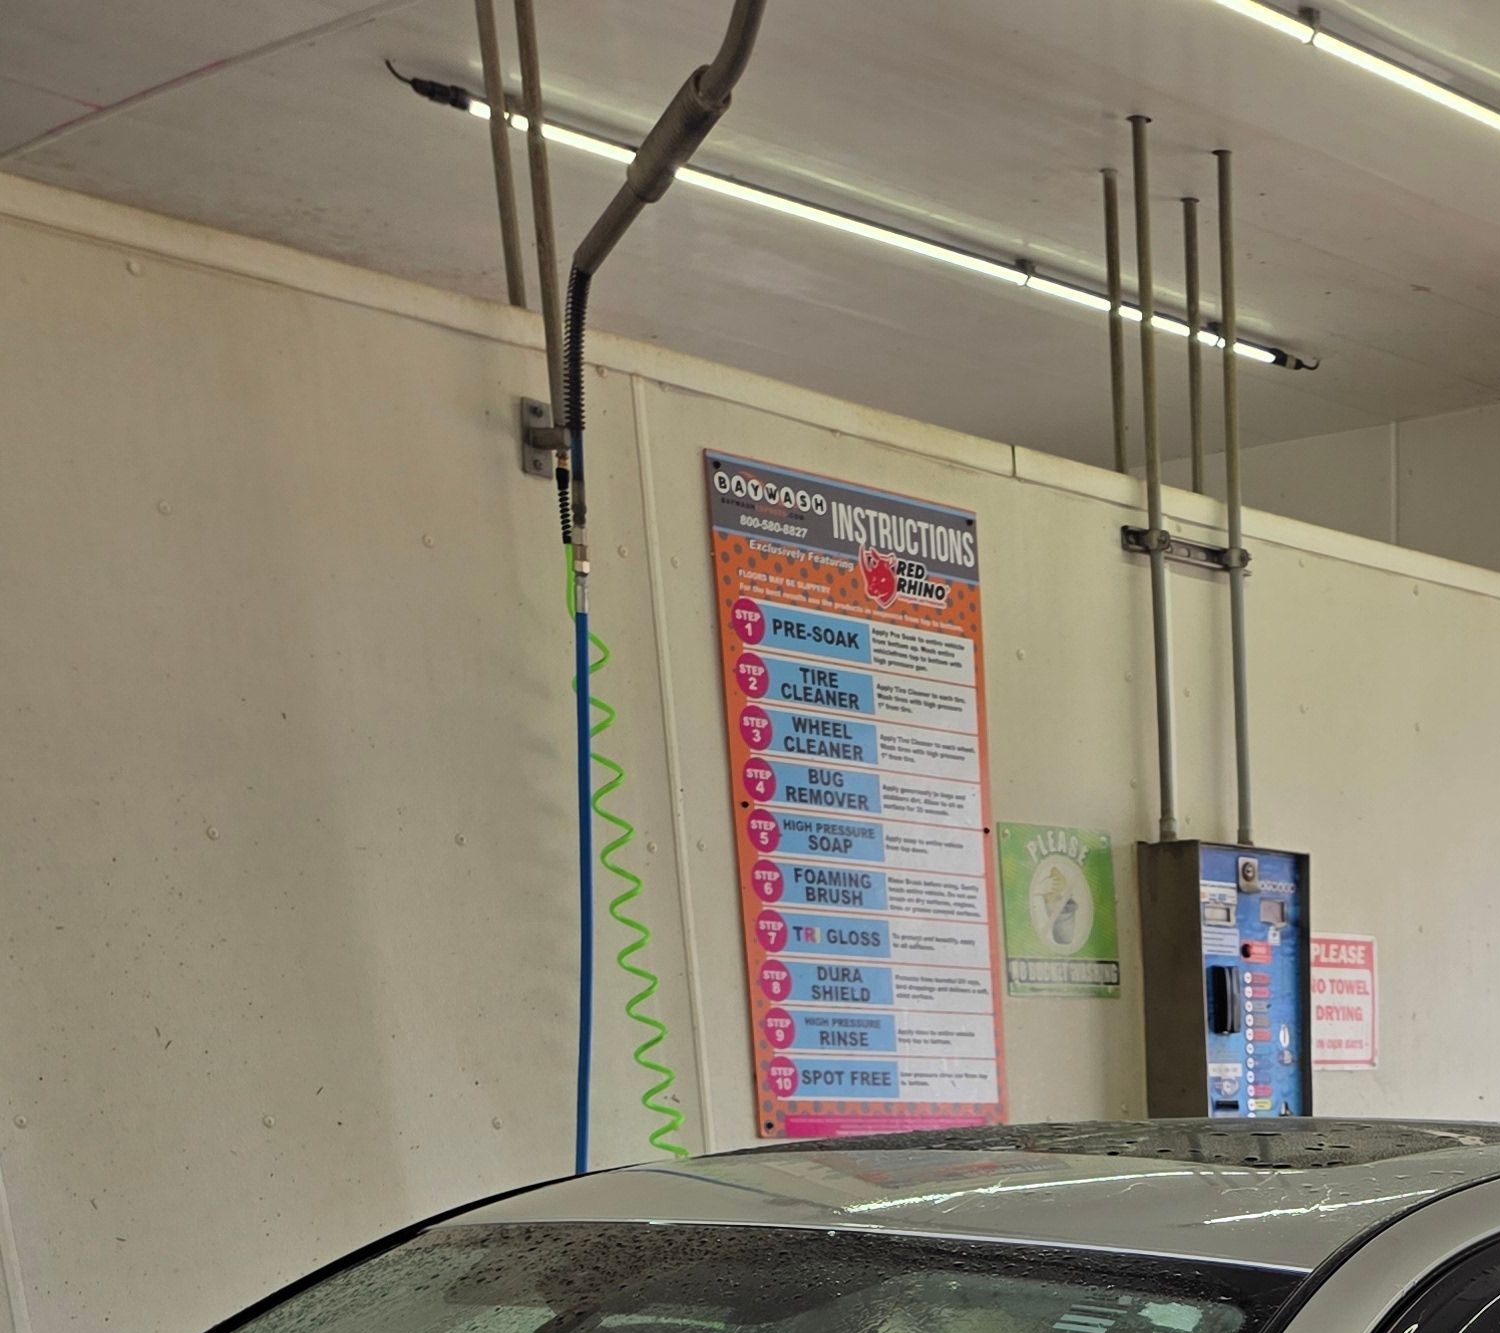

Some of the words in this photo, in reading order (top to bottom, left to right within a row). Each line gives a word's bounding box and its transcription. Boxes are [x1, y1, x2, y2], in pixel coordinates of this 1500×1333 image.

[716, 473, 826, 514] BAYWASH
[832, 502, 975, 568] INSTRUCTIONS
[750, 540, 805, 561] Exclusively
[808, 552, 854, 571] Featuring
[897, 561, 925, 580] RED
[897, 579, 946, 600] RHINO
[735, 609, 760, 621] STEP
[744, 623, 753, 636] 1
[773, 619, 859, 649] PRE-SOAK
[739, 664, 764, 676] STEP
[799, 668, 838, 688] TIRE
[748, 677, 758, 691] 2
[781, 683, 859, 710] CLEANER
[743, 717, 768, 729] STEP
[792, 717, 852, 740] WHEEL
[752, 730, 762, 742] 3
[784, 736, 863, 762] CLEANER
[746, 768, 772, 780] STEP
[809, 769, 843, 786] BUG
[755, 782, 765, 794] 4
[786, 786, 869, 811] REMOVER
[751, 820, 775, 832] STEP
[783, 819, 813, 834] HIGH
[817, 823, 875, 839] PRESSURE
[759, 833, 769, 845] 5
[809, 836, 852, 853] SOAP
[1026, 831, 1089, 866] PLEASE
[755, 870, 779, 882] STEP
[794, 868, 872, 889] FOAMING
[764, 883, 773, 895] 6
[806, 887, 863, 906] BRUSH
[759, 921, 783, 932] STEP
[768, 933, 777, 944] 7
[827, 929, 881, 947] GLOSS
[1311, 942, 1365, 965] PLEASE
[763, 970, 787, 981] STEP
[817, 967, 863, 983] DURA
[772, 982, 781, 993] 8
[811, 985, 870, 1003] SHIELD
[1329, 979, 1370, 996] TOWEL
[1316, 1004, 1363, 1021] DRYING
[767, 1018, 791, 1029] STEP
[804, 1018, 828, 1028] HIGH
[831, 1019, 881, 1029] PRESSURE
[775, 1030, 785, 1041] 9
[820, 1031, 869, 1047] RINSE
[770, 1067, 794, 1077] STEP
[801, 1069, 844, 1085] SPOT
[851, 1070, 892, 1086] FREE
[776, 1078, 792, 1090] 10
